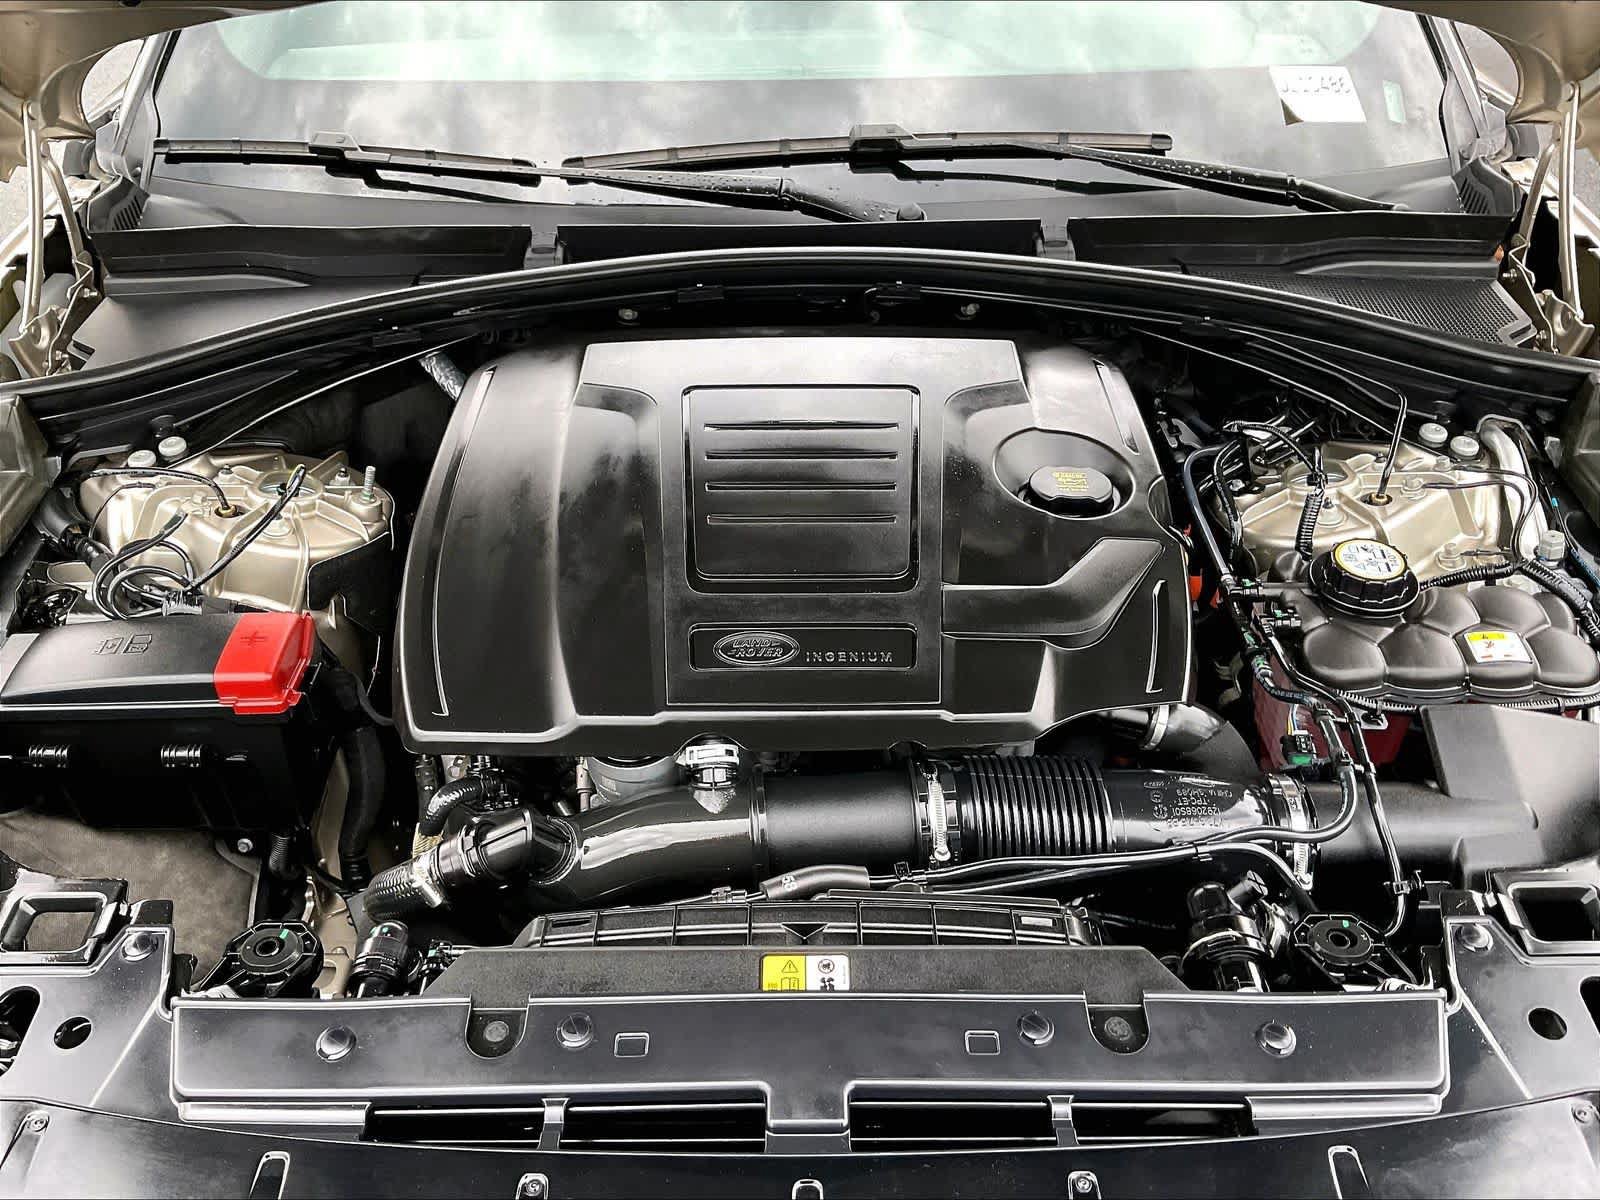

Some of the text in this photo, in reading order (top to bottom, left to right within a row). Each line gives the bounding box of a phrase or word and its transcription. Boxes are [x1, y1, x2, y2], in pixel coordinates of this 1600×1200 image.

[732, 638, 774, 648] LAND
[733, 648, 784, 658] ROVER
[806, 651, 893, 663] INGENIUM
